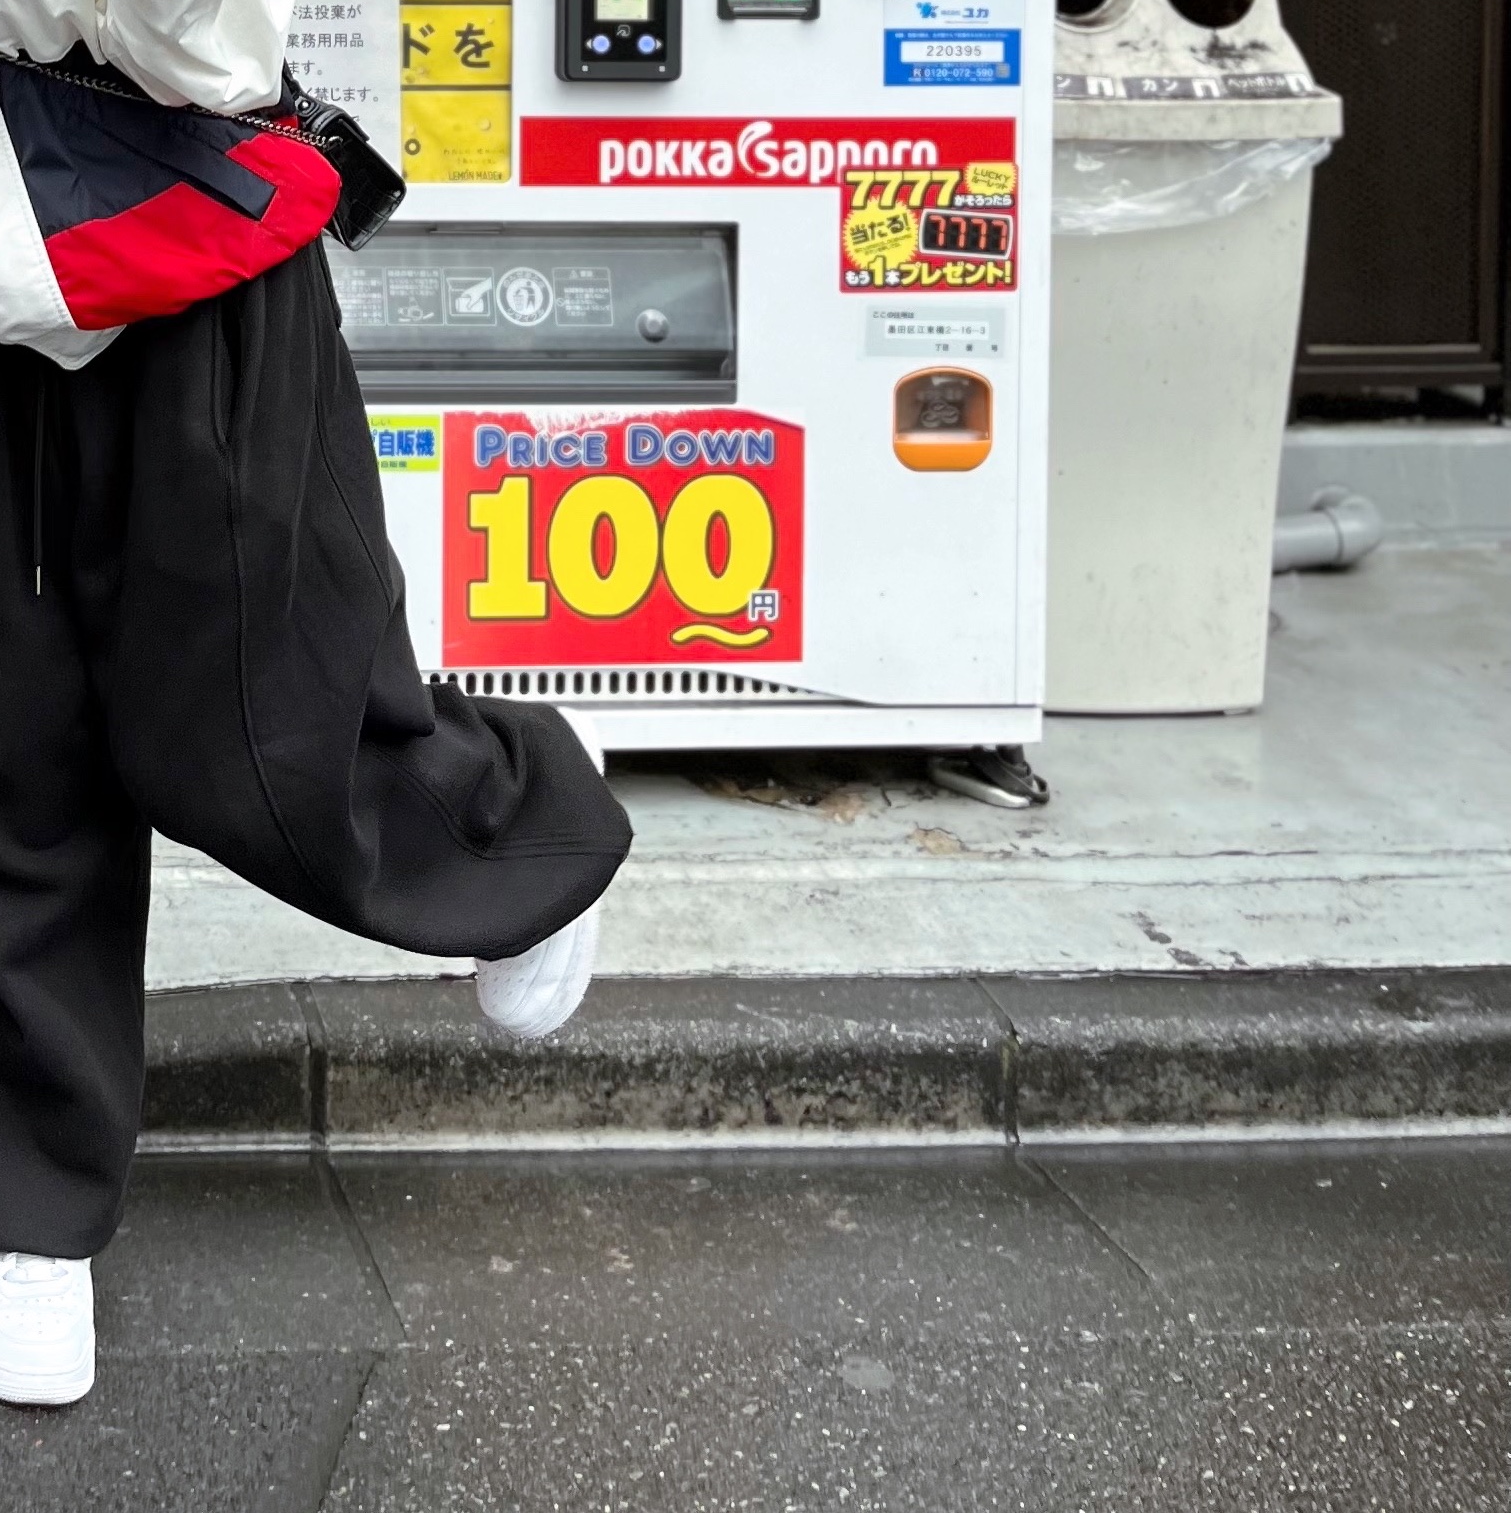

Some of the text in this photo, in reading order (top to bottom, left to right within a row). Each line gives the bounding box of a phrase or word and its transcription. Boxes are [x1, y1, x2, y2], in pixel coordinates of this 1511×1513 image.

[962, 7, 990, 19] ユカ
[926, 45, 982, 57] 220395
[924, 68, 994, 77] 0120-072-590
[1228, 76, 1286, 88] ペットボトル
[1142, 78, 1178, 93] カン
[599, 139, 938, 183] pokka sapporo
[971, 176, 1008, 190] ルーレット
[973, 167, 1011, 182] LUCKY
[845, 170, 961, 209] 7777
[954, 194, 1012, 207] がそろったら
[850, 213, 911, 244] 当たる!
[930, 215, 1008, 250] 7777
[845, 255, 1012, 286] もう1本プレゼント!
[378, 428, 435, 457] 自販機
[474, 424, 775, 467] PRICE DOWN
[468, 473, 775, 619] 100
